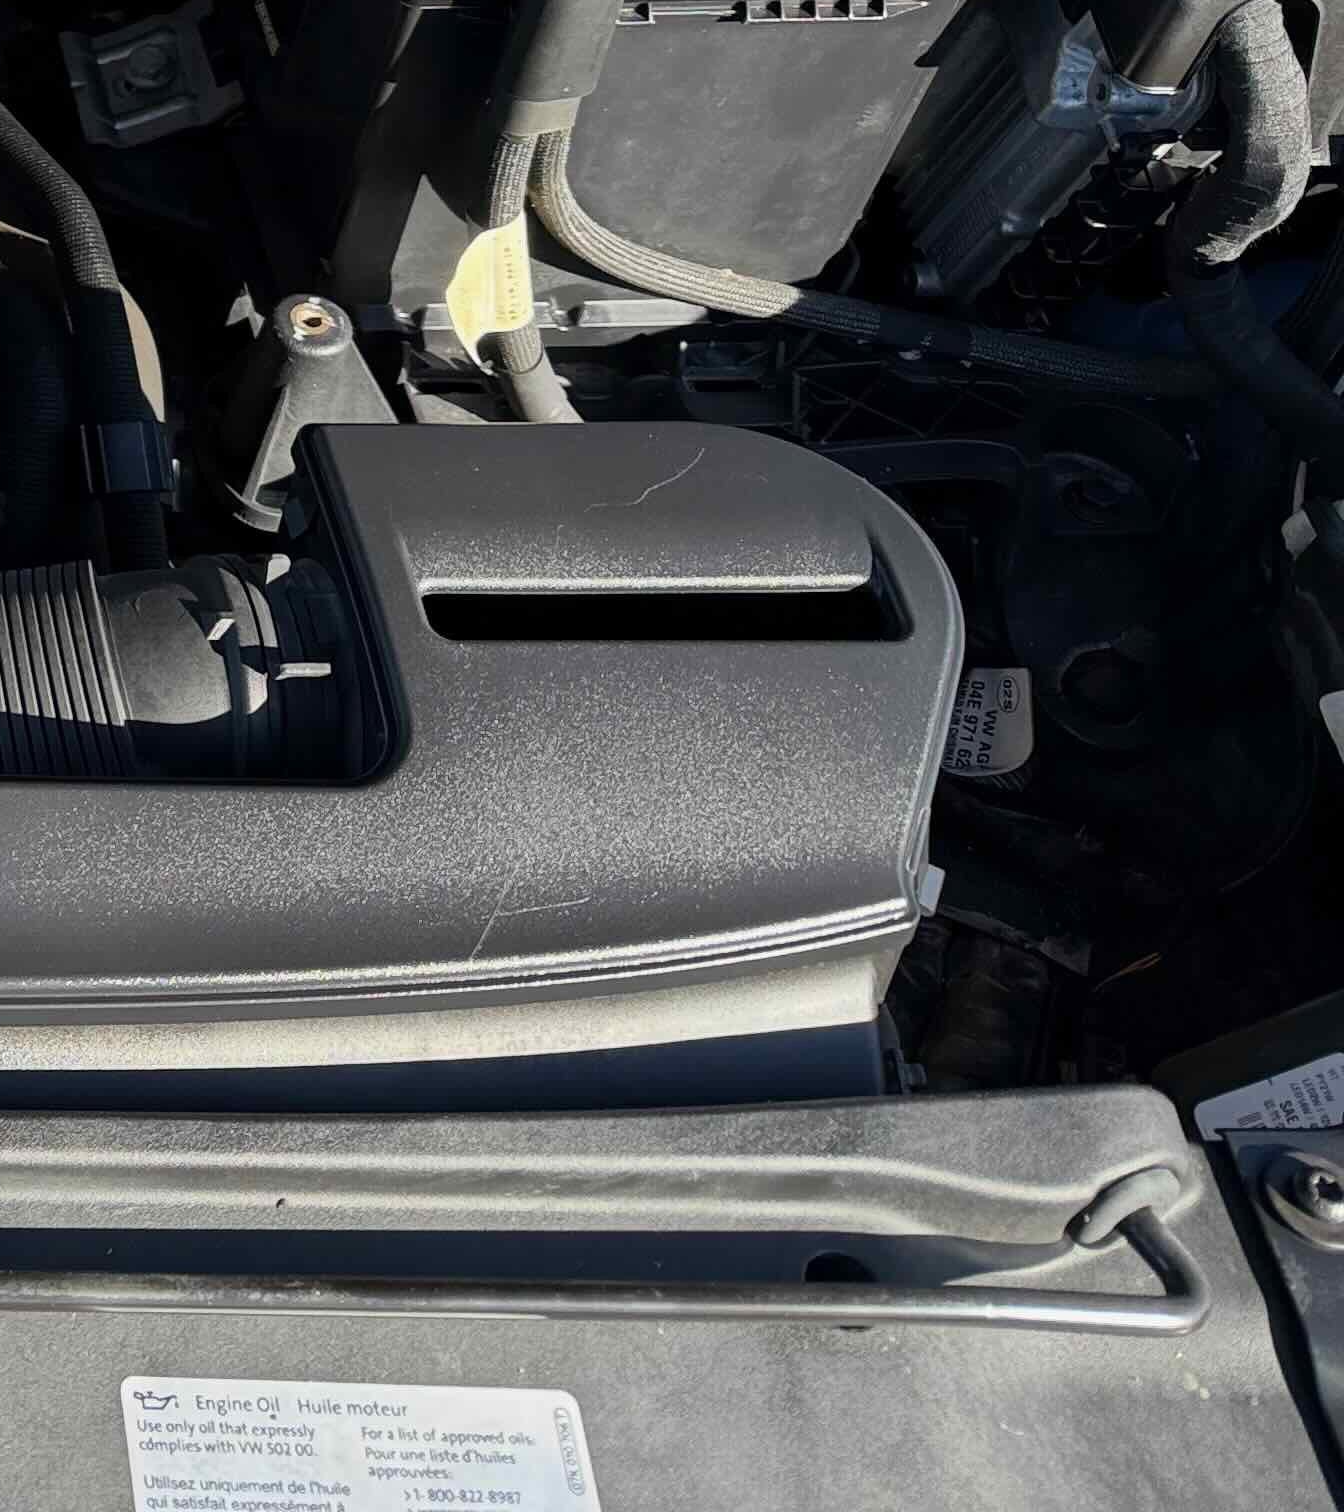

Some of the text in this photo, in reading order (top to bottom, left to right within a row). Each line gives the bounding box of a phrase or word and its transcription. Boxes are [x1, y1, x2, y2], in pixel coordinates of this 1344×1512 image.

[966, 680, 986, 710] 04E
[960, 713, 979, 744] 971
[981, 708, 999, 737] VW
[1280, 1100, 1300, 1125] SAE
[195, 1395, 408, 1417] Engine Oil Huile moteur
[137, 1419, 315, 1441] Use only oil that expressly
[360, 1427, 383, 1440] For
[398, 1428, 418, 1441] list
[423, 1428, 436, 1442] of
[441, 1430, 505, 1446] approved
[139, 1439, 201, 1455] complies
[204, 1440, 236, 1454] with
[239, 1441, 263, 1455] VW
[267, 1442, 290, 1456] 502
[365, 1447, 517, 1465] Pour une liste d'huiles
[143, 1474, 195, 1490] Utilisez
[200, 1477, 284, 1494] uniquement
[287, 1480, 306, 1494] de
[146, 1496, 168, 1511] qui
[172, 1496, 227, 1511] satisfait
